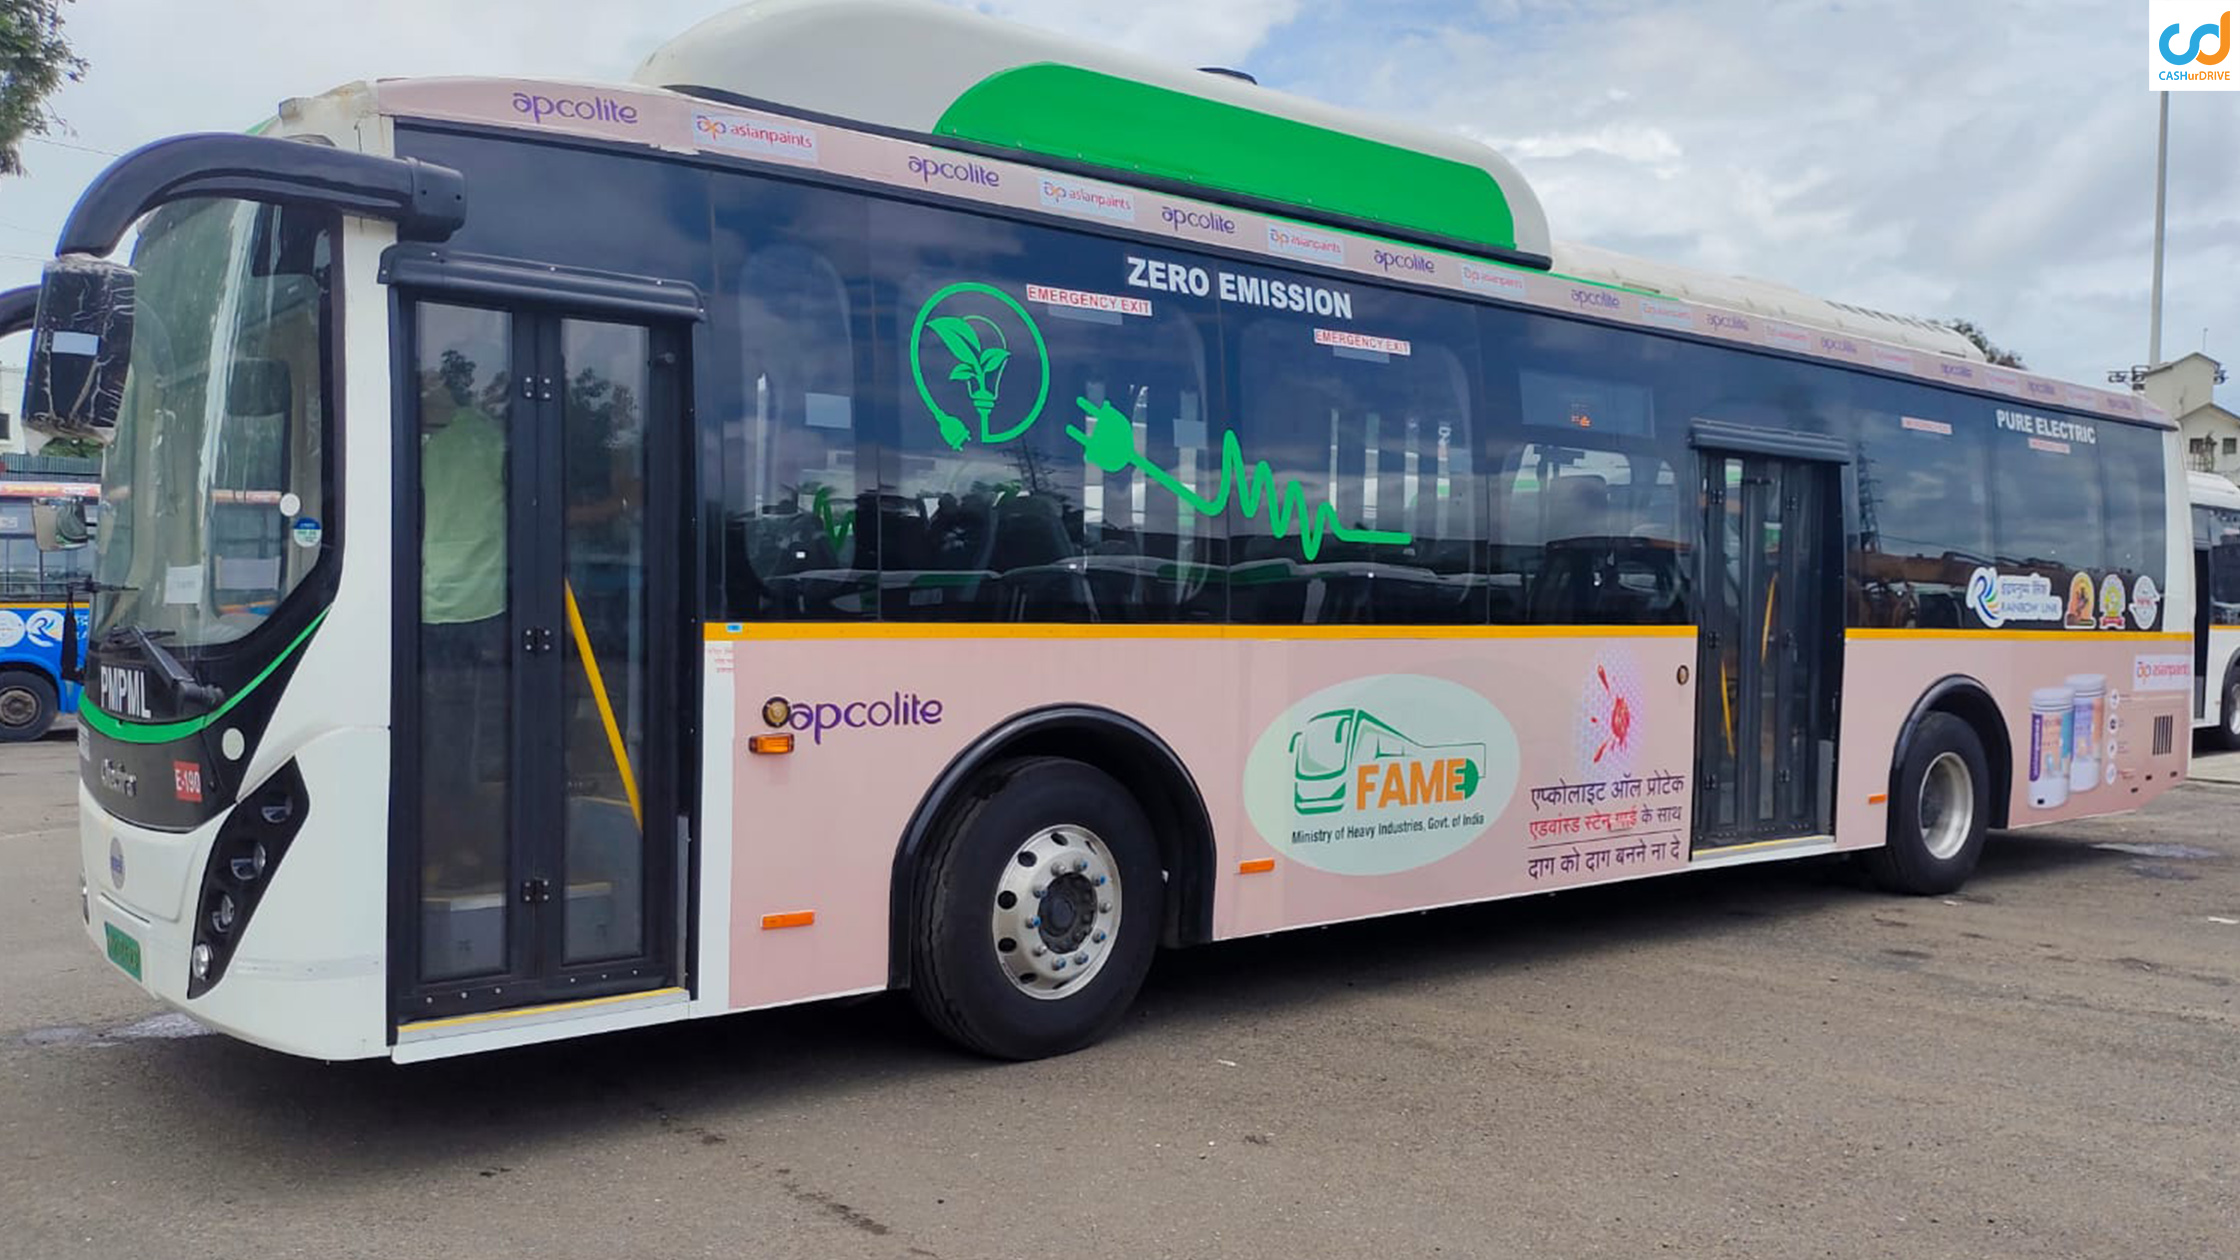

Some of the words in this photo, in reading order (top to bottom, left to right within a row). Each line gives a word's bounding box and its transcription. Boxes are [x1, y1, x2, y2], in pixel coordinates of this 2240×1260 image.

[513, 91, 638, 125] apcolite
[730, 122, 813, 149] asianpaints
[908, 155, 1000, 188] apcolite
[1069, 189, 1132, 211] asianpaints
[1161, 206, 1236, 234] apcolite
[1374, 249, 1435, 274] apcolite
[1027, 286, 1117, 310] EMERGENCY
[1121, 299, 1150, 314] EXIT
[1127, 256, 1210, 297] ZERO
[1218, 272, 1353, 319] EMISSION
[1315, 330, 1384, 349] EMERGENCY
[1995, 408, 2034, 434] PURE
[2036, 416, 2097, 444] ELECTRIC
[101, 665, 151, 718] PMPML
[789, 690, 943, 745] apcolite
[1356, 758, 1466, 810] FAME
[1611, 772, 1642, 798] ऑल
[1646, 769, 1685, 795] प्रोटेक
[1292, 830, 1332, 844] Ministry
[1335, 827, 1345, 839] of
[1347, 825, 1375, 839] Heavy
[1428, 816, 1450, 830] Govt.
[1452, 815, 1461, 828] of
[1462, 812, 1485, 826] India
[1641, 803, 1653, 824] के
[1657, 806, 1682, 823] साथ
[1529, 857, 1554, 880] दाग
[1560, 847, 1581, 874] को
[1586, 849, 1610, 871] दाग
[1616, 838, 1647, 865] बनने
[1651, 842, 1667, 861] ना
[1670, 834, 1681, 859] दे
